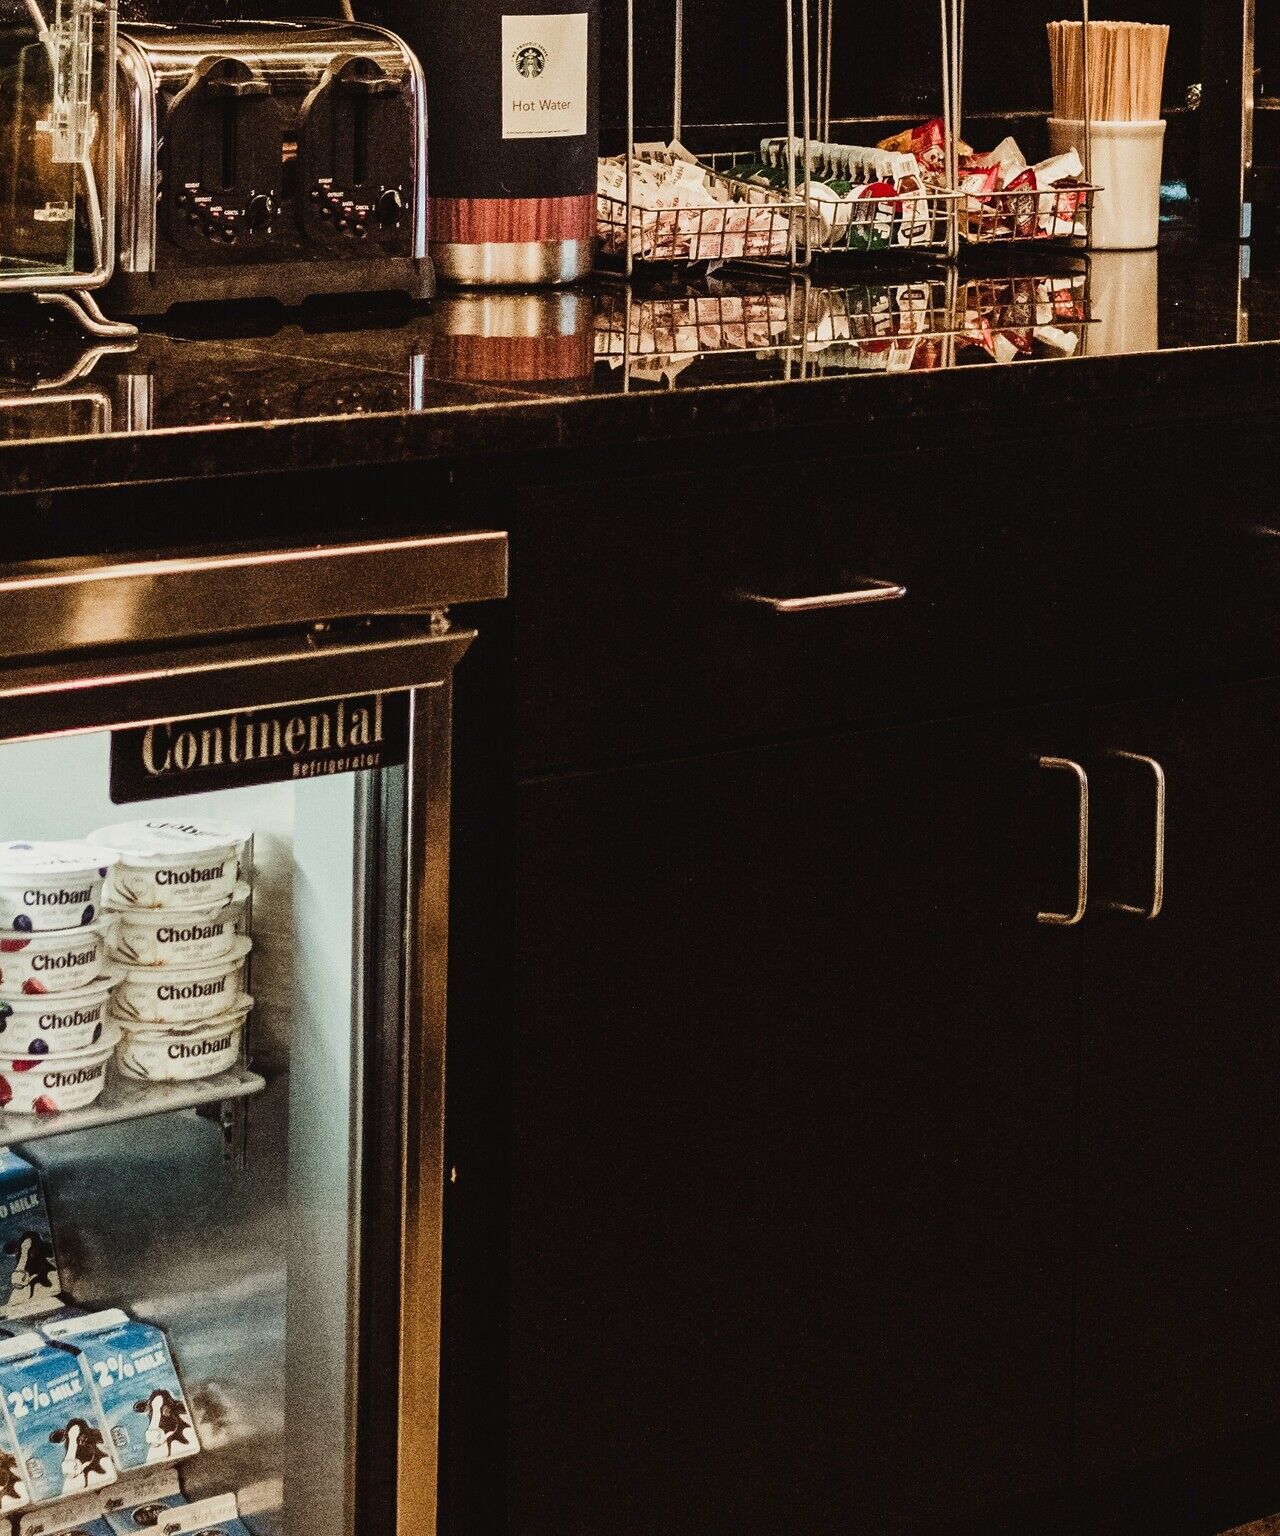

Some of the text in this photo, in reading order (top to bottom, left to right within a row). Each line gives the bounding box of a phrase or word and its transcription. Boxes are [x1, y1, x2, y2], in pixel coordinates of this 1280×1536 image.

[512, 99, 571, 112] Hot Water
[141, 693, 385, 776] Continental
[10, 1192, 39, 1215] MILK
[93, 1353, 135, 1388] 2%
[134, 1350, 167, 1374] MILK
[8, 1382, 50, 1419] 2%
[50, 1378, 83, 1404] MILK
